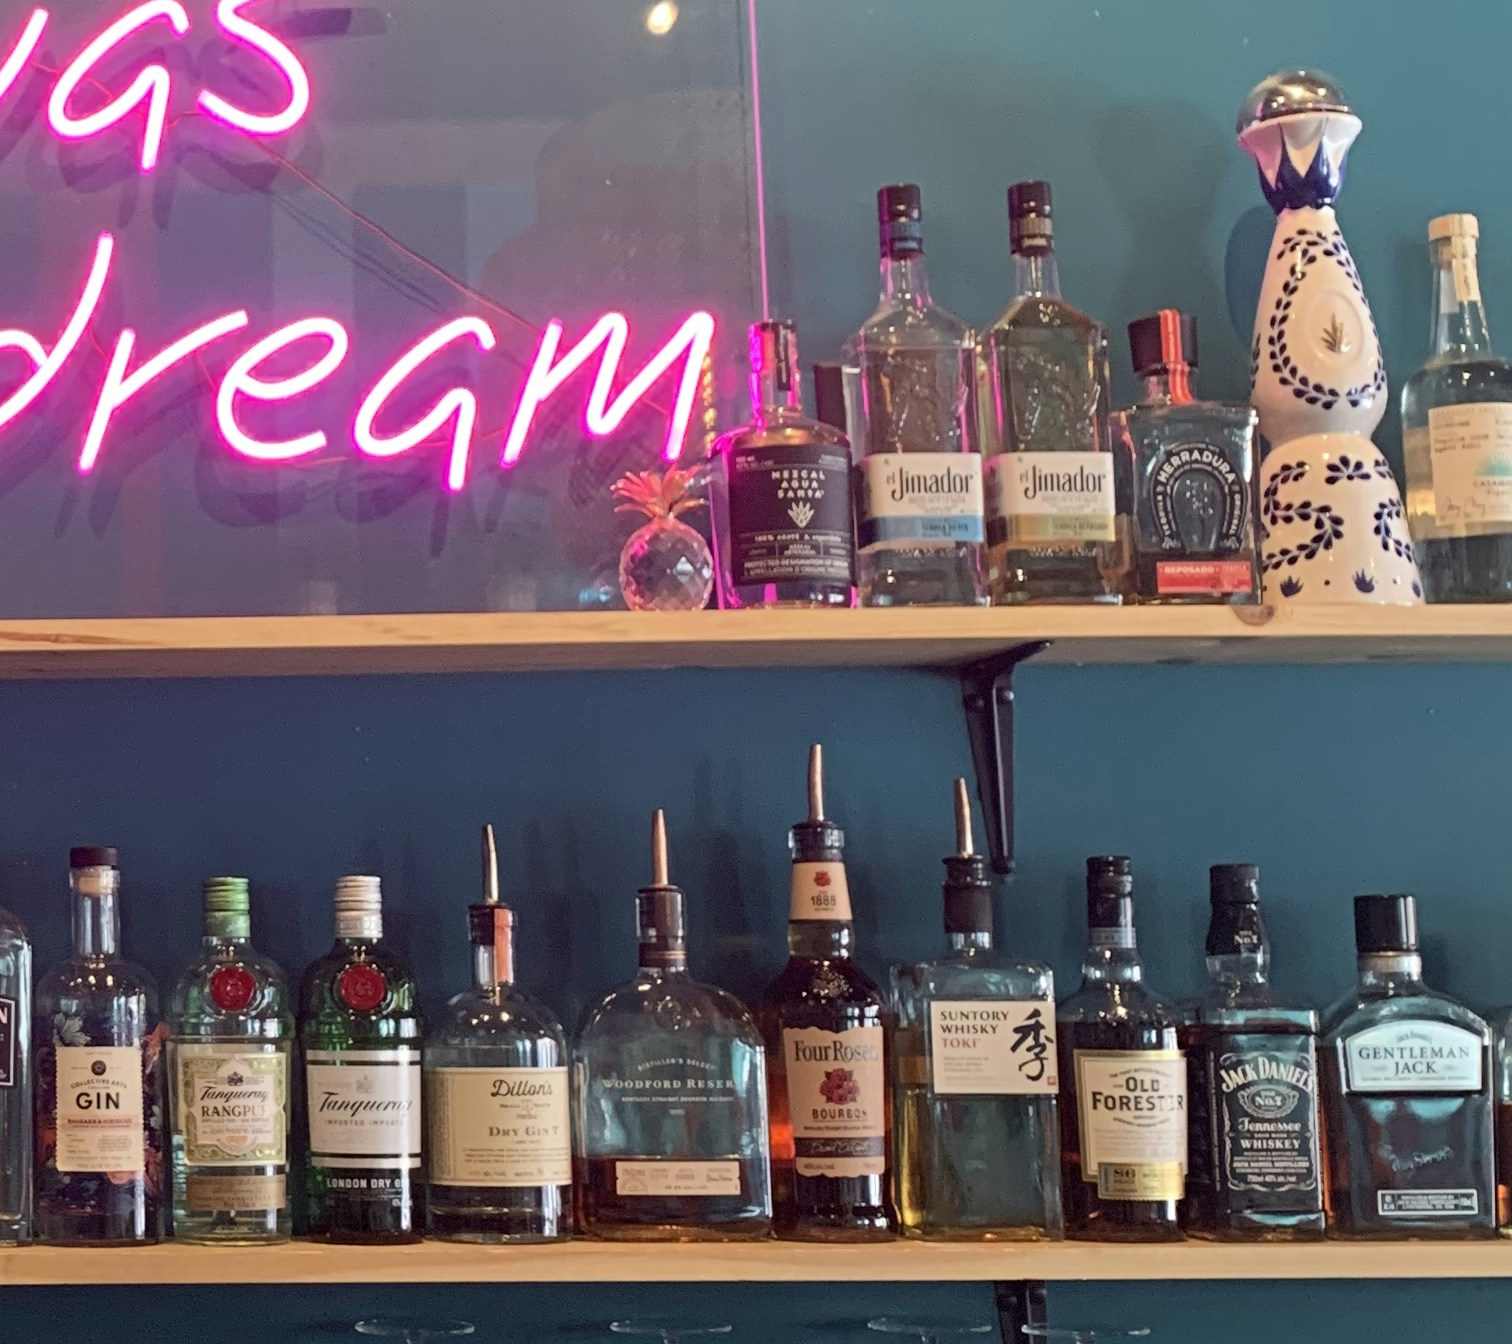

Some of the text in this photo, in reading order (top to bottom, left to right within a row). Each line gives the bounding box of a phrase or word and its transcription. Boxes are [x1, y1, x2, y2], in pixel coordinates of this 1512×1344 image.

[1157, 449, 1236, 484] HERRADURA
[771, 469, 826, 480] MEZCAL
[891, 466, 974, 502] Jimador
[1024, 465, 1107, 500] Jimador
[810, 894, 837, 906] 1888
[940, 1010, 1010, 1022] SUNTORY
[940, 1023, 999, 1035] WHISKY
[942, 1037, 977, 1049] TOKI
[1009, 1007, 1055, 1082] 季
[794, 1040, 832, 1062] Four
[1358, 1046, 1470, 1060] GENTLEMAN
[1394, 1061, 1438, 1076] JACK
[70, 1078, 127, 1089] COLLECTIVE ARTS
[602, 1078, 735, 1089] WOODFORD RESER
[1124, 1076, 1161, 1093] OLD
[1219, 1062, 1259, 1093] JACK
[199, 1085, 268, 1103] Tanqueray
[490, 1079, 553, 1097] Dillon's
[75, 1092, 120, 1110] GIN
[318, 1091, 413, 1118] Tanqueray
[811, 1108, 867, 1120] BOURBON
[324, 1119, 365, 1127] IMPORTED
[1237, 1117, 1302, 1132] Tennessee
[488, 1126, 520, 1136] DRY
[524, 1126, 549, 1136] GIN
[1240, 1139, 1301, 1149] WHISKEY
[326, 1178, 391, 1188] LONDON DRY
